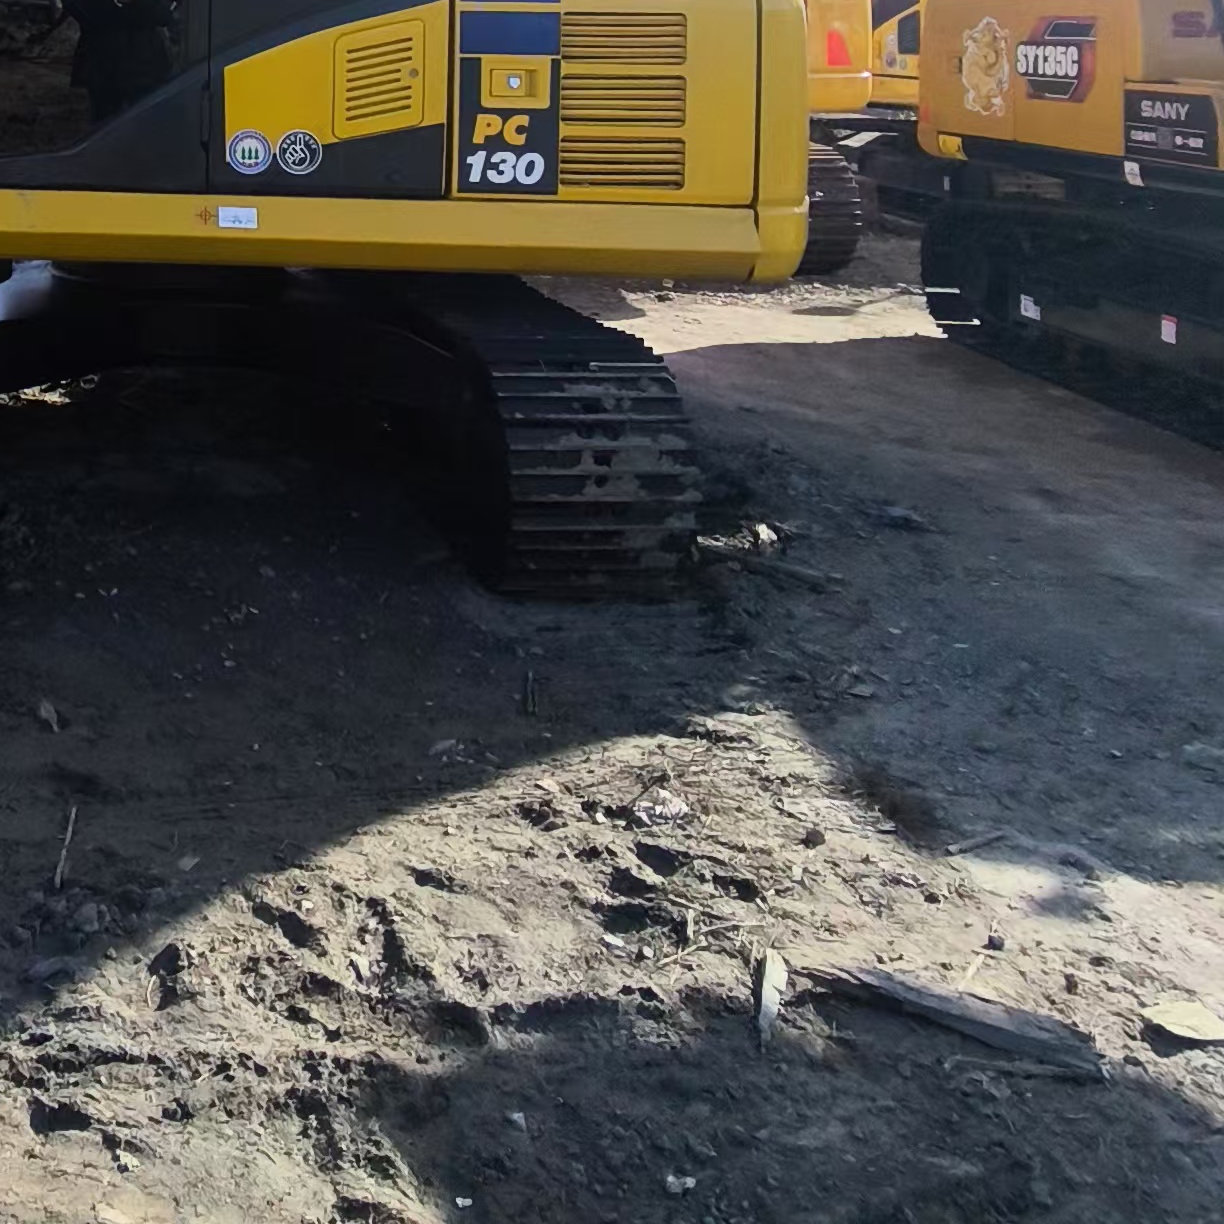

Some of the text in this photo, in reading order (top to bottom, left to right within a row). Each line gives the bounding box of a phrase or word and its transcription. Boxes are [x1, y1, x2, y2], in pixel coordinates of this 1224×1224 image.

[1016, 44, 1079, 77] SY135C
[1140, 99, 1190, 121] SANY
[472, 113, 530, 146] PC
[466, 150, 545, 185] 130
